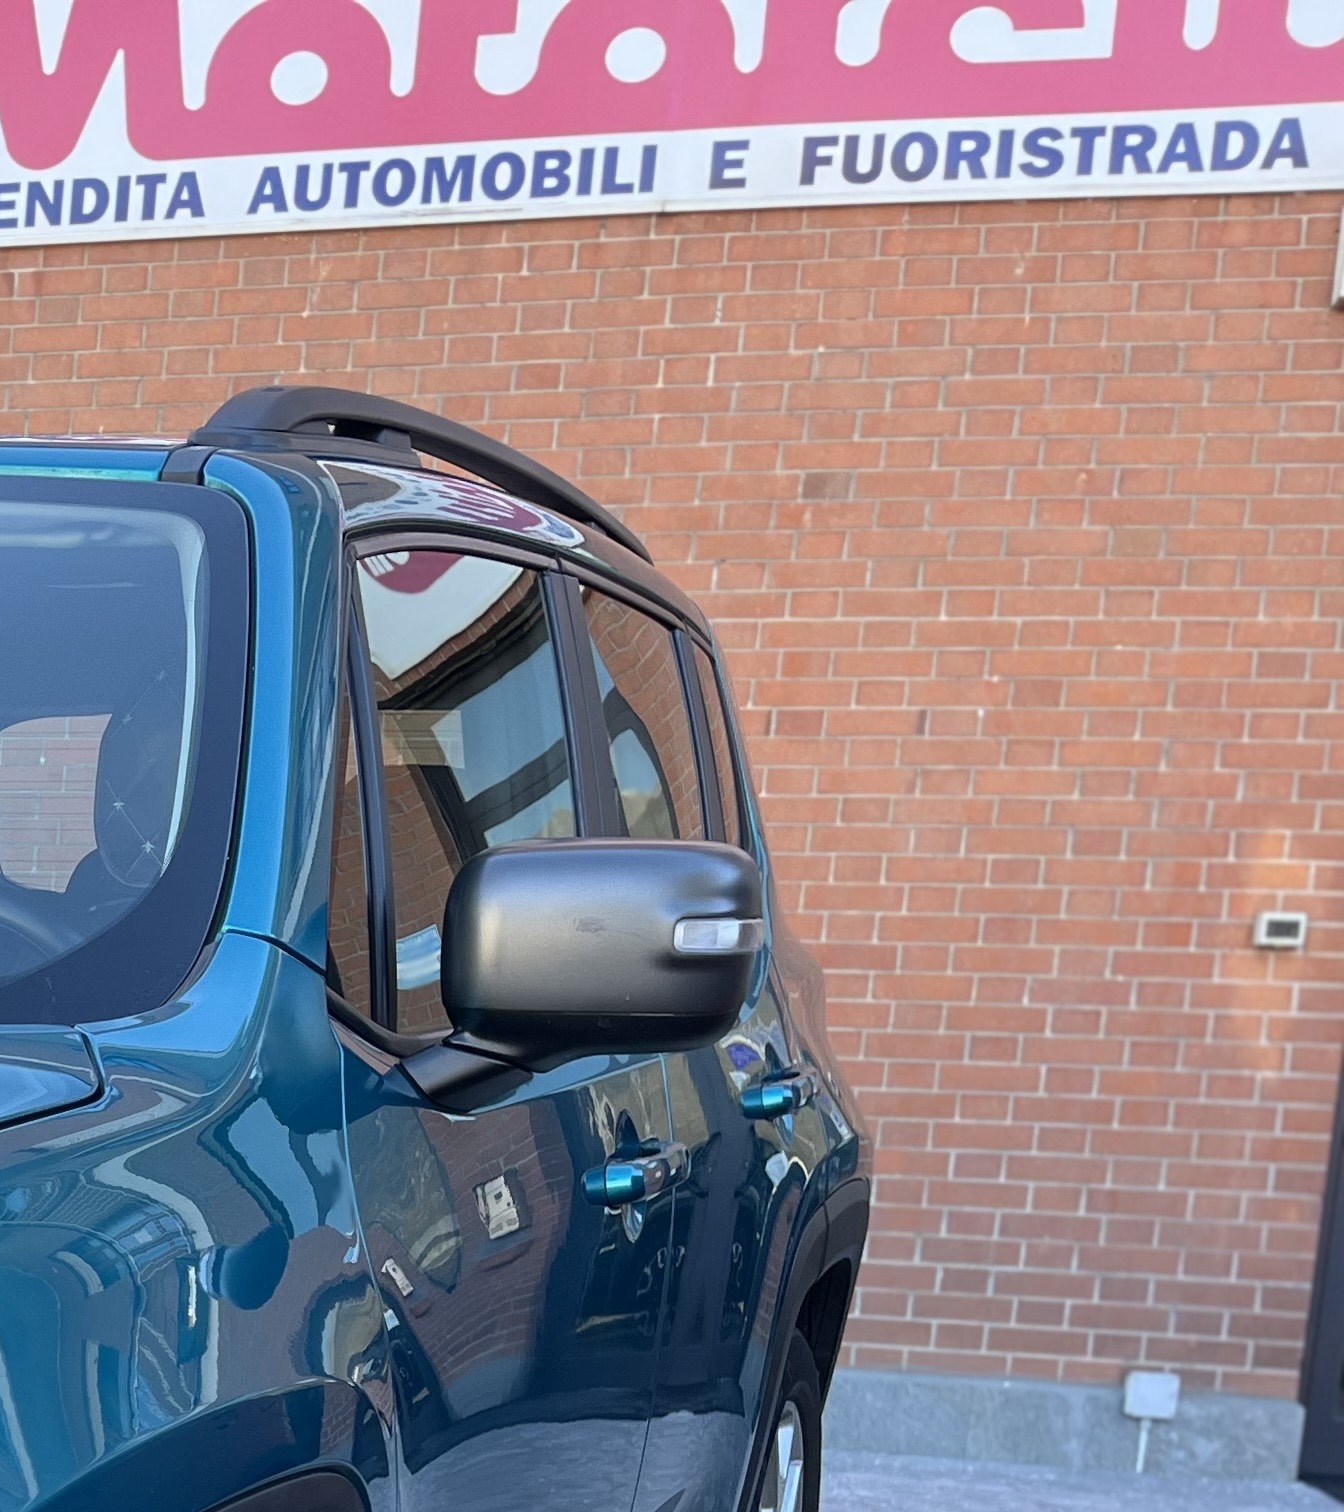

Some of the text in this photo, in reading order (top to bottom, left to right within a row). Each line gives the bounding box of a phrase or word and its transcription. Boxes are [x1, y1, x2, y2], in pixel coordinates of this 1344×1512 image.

[248, 144, 658, 216] AUTOMOBILI
[709, 139, 750, 190] E
[799, 117, 1310, 186] FUORISTRADA
